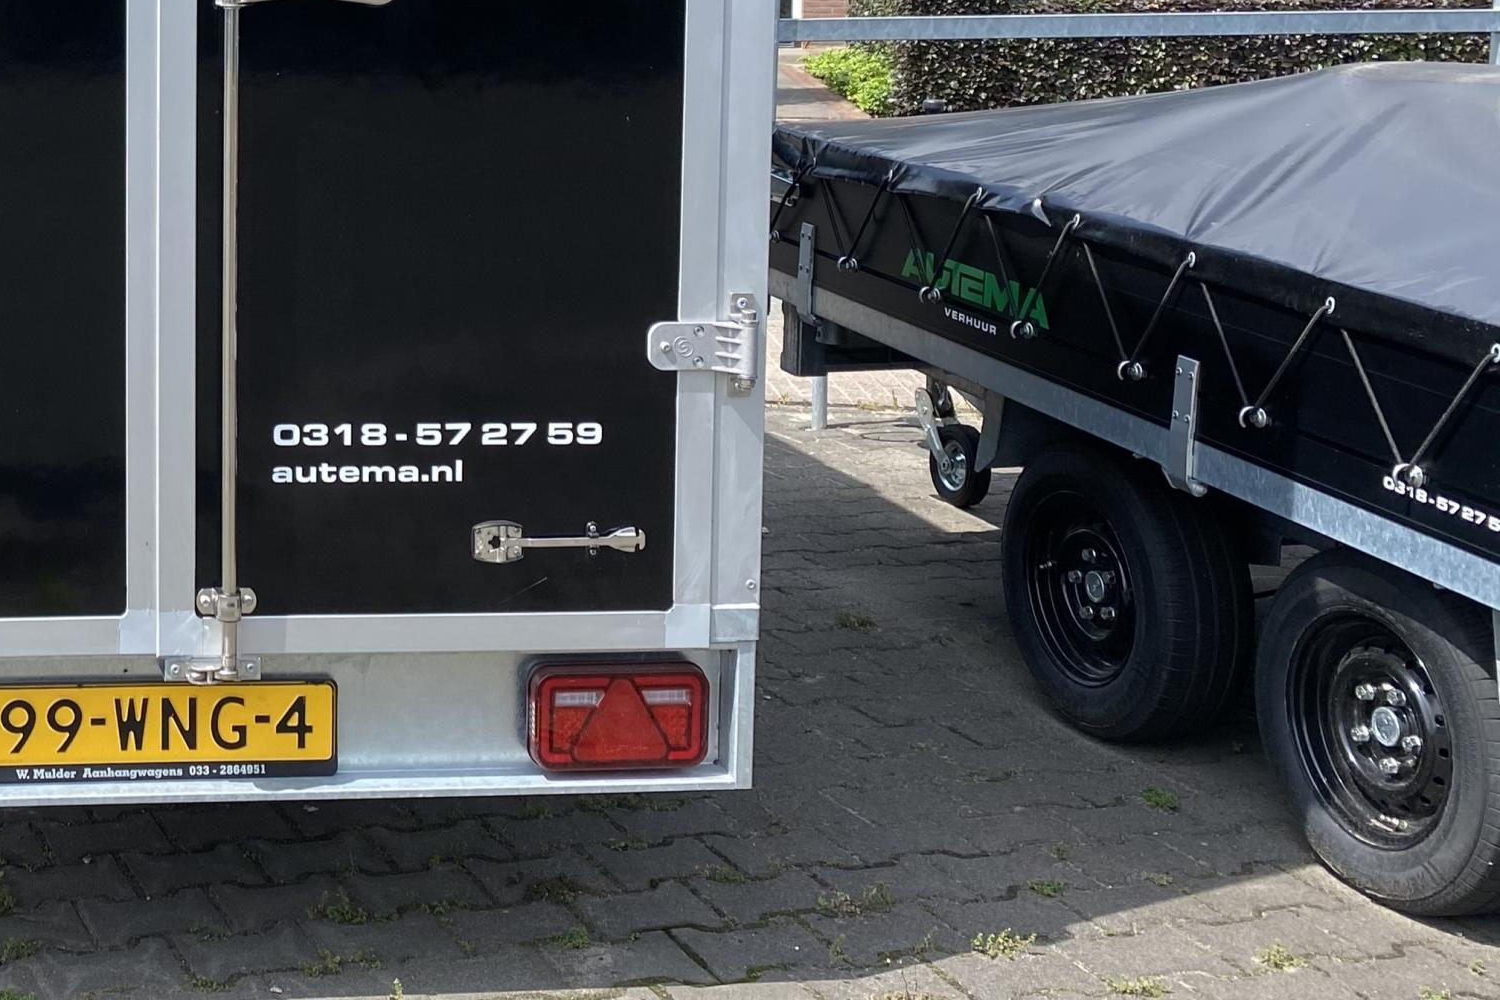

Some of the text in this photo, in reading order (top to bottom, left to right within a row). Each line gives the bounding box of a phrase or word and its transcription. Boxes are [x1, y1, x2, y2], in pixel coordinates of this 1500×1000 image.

[944, 306, 997, 336] VERHUUR
[271, 459, 463, 484] autema.nl
[0, 695, 314, 754] 99-WNG-4
[16, 769, 30, 780] W.
[33, 768, 77, 780] Mulder
[82, 766, 183, 779] Aanhangwagens
